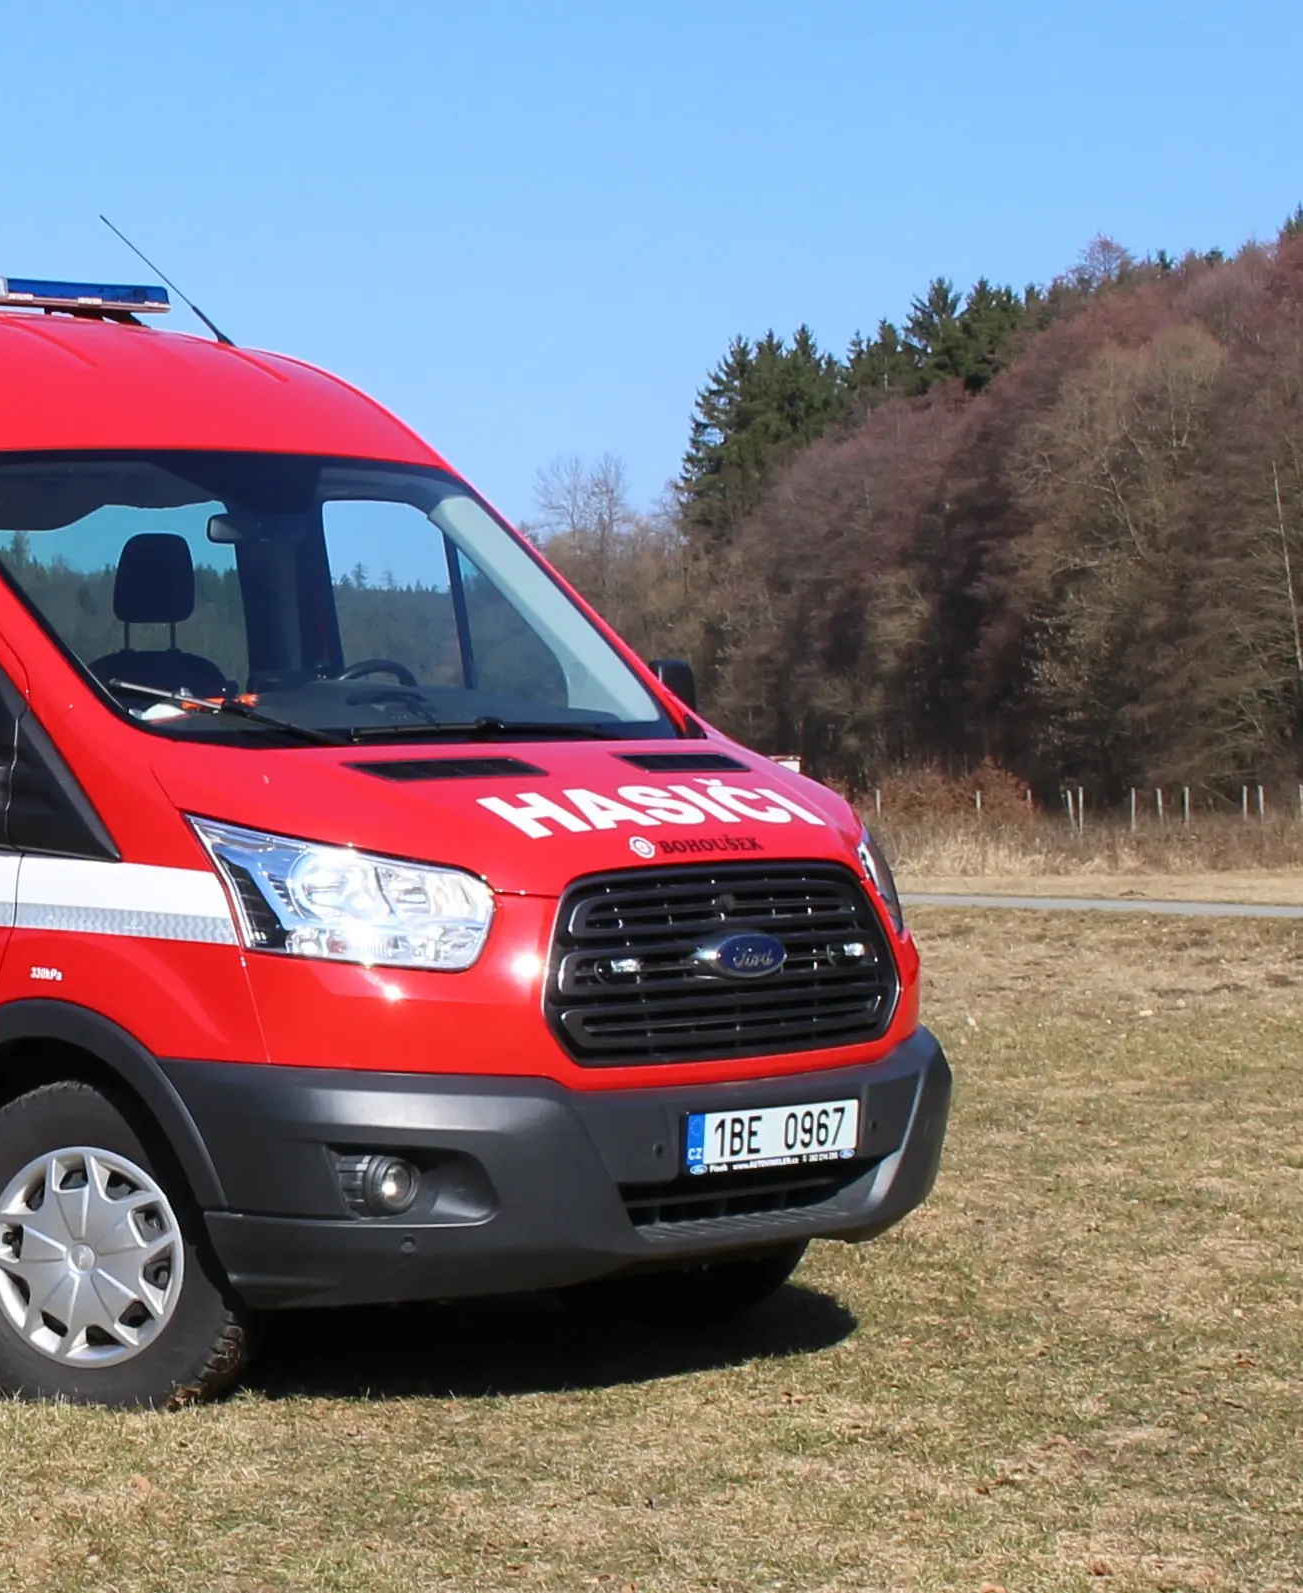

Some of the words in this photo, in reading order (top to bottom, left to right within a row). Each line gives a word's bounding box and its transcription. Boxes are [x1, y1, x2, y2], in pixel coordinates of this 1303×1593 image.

[476, 778, 826, 839] HASIČI
[659, 834, 764, 854] BOHOUŠEK
[714, 1115, 762, 1157] 1BE
[783, 1106, 846, 1150] 0967
[688, 1147, 702, 1160] CZ
